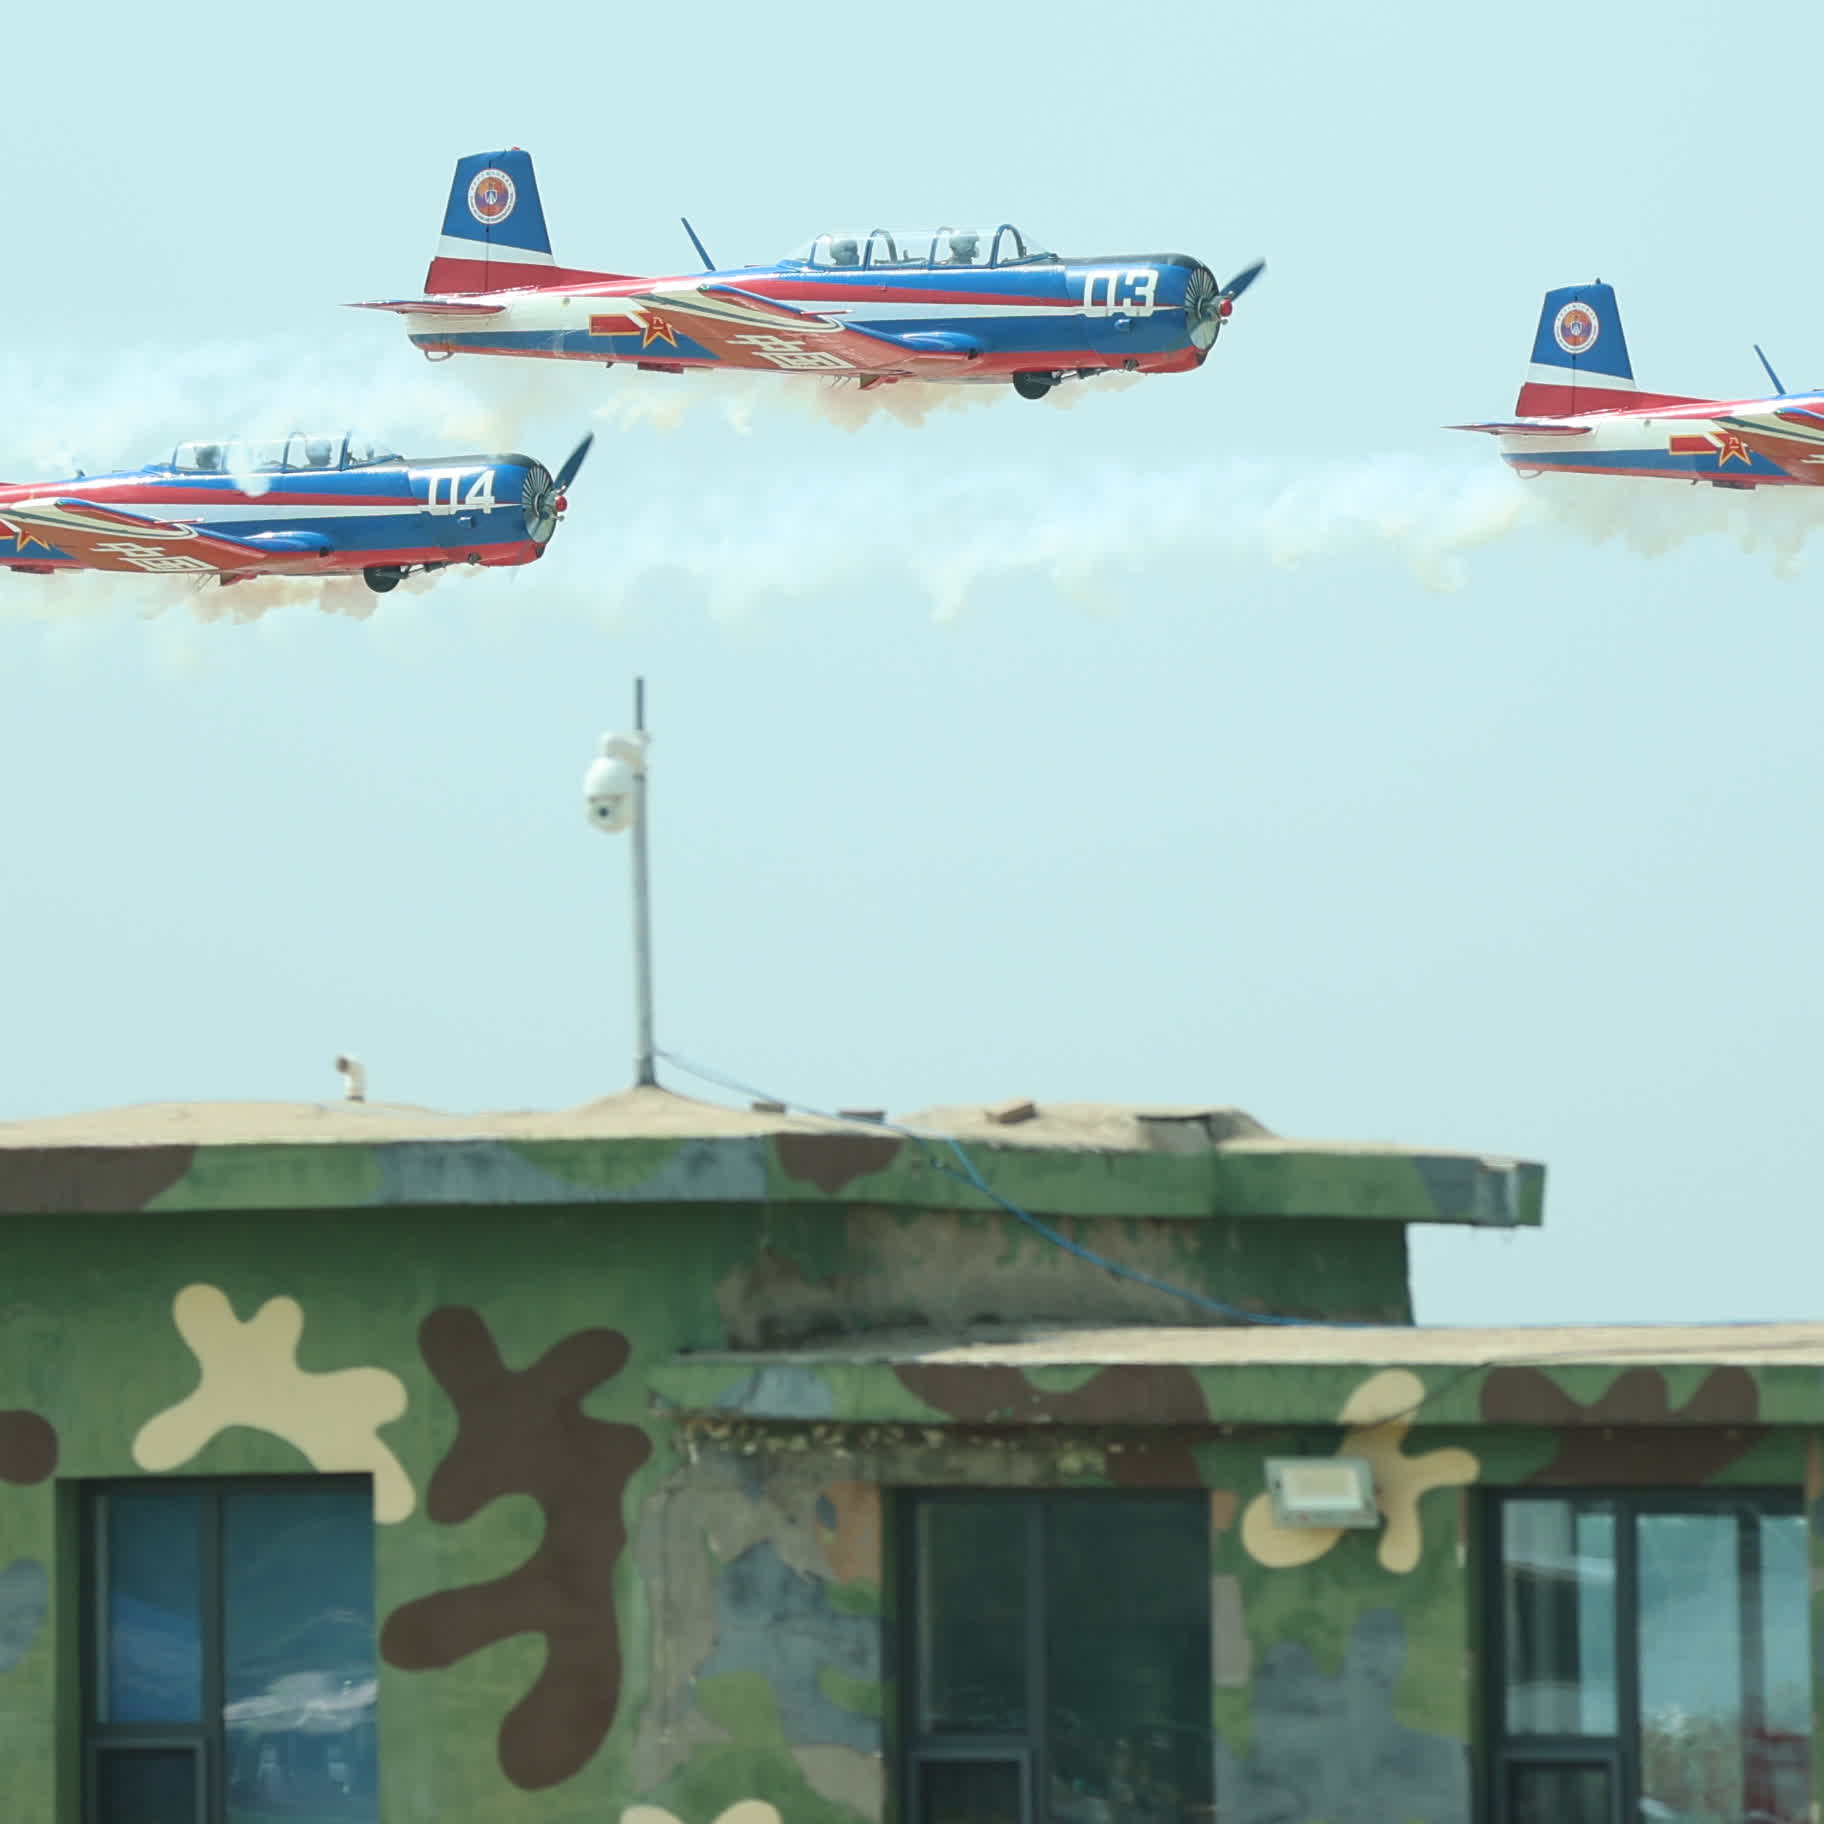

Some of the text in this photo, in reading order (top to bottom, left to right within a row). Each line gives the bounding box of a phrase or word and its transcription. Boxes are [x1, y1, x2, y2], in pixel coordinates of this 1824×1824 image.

[1083, 270, 1158, 316] 03
[725, 334, 857, 369] 中国
[428, 470, 495, 516] 04
[88, 542, 220, 572] 中国
